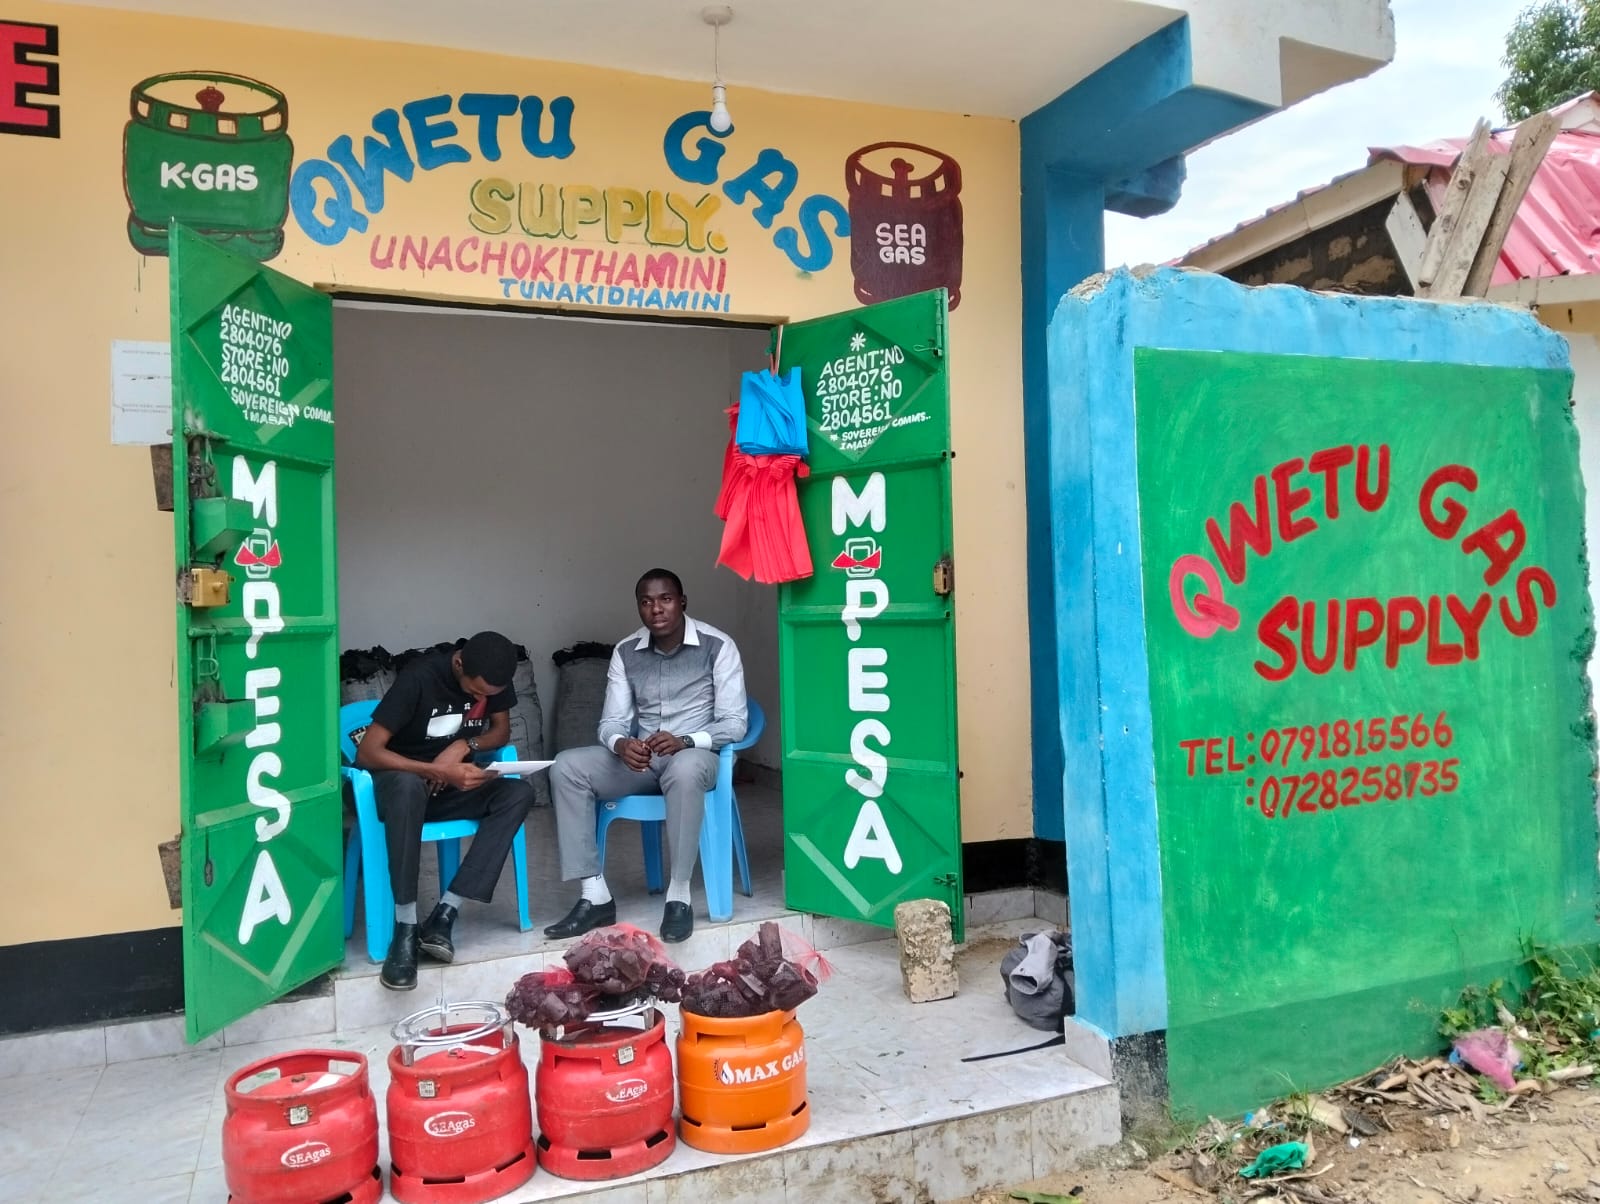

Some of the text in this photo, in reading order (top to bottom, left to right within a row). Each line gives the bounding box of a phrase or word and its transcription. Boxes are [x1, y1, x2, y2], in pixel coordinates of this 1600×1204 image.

[160, 161, 259, 191] K-GAS
[290, 93, 851, 272] QWETU GAS
[875, 222, 927, 247] SEA
[370, 234, 728, 293] UNACHOKITHAMINI
[879, 246, 926, 265] GAS
[499, 278, 730, 313] TUNAKIDHAMINI
[219, 322, 282, 356] 2804076
[220, 361, 282, 397] 2804561
[816, 366, 894, 396] 2804076
[818, 402, 892, 431] 2804561
[1169, 444, 1558, 639] QWETU GAS
[1253, 592, 1493, 682] SUPPLY
[734, 1060, 781, 1085] MAX
[288, 1147, 332, 1166] SEAgas
